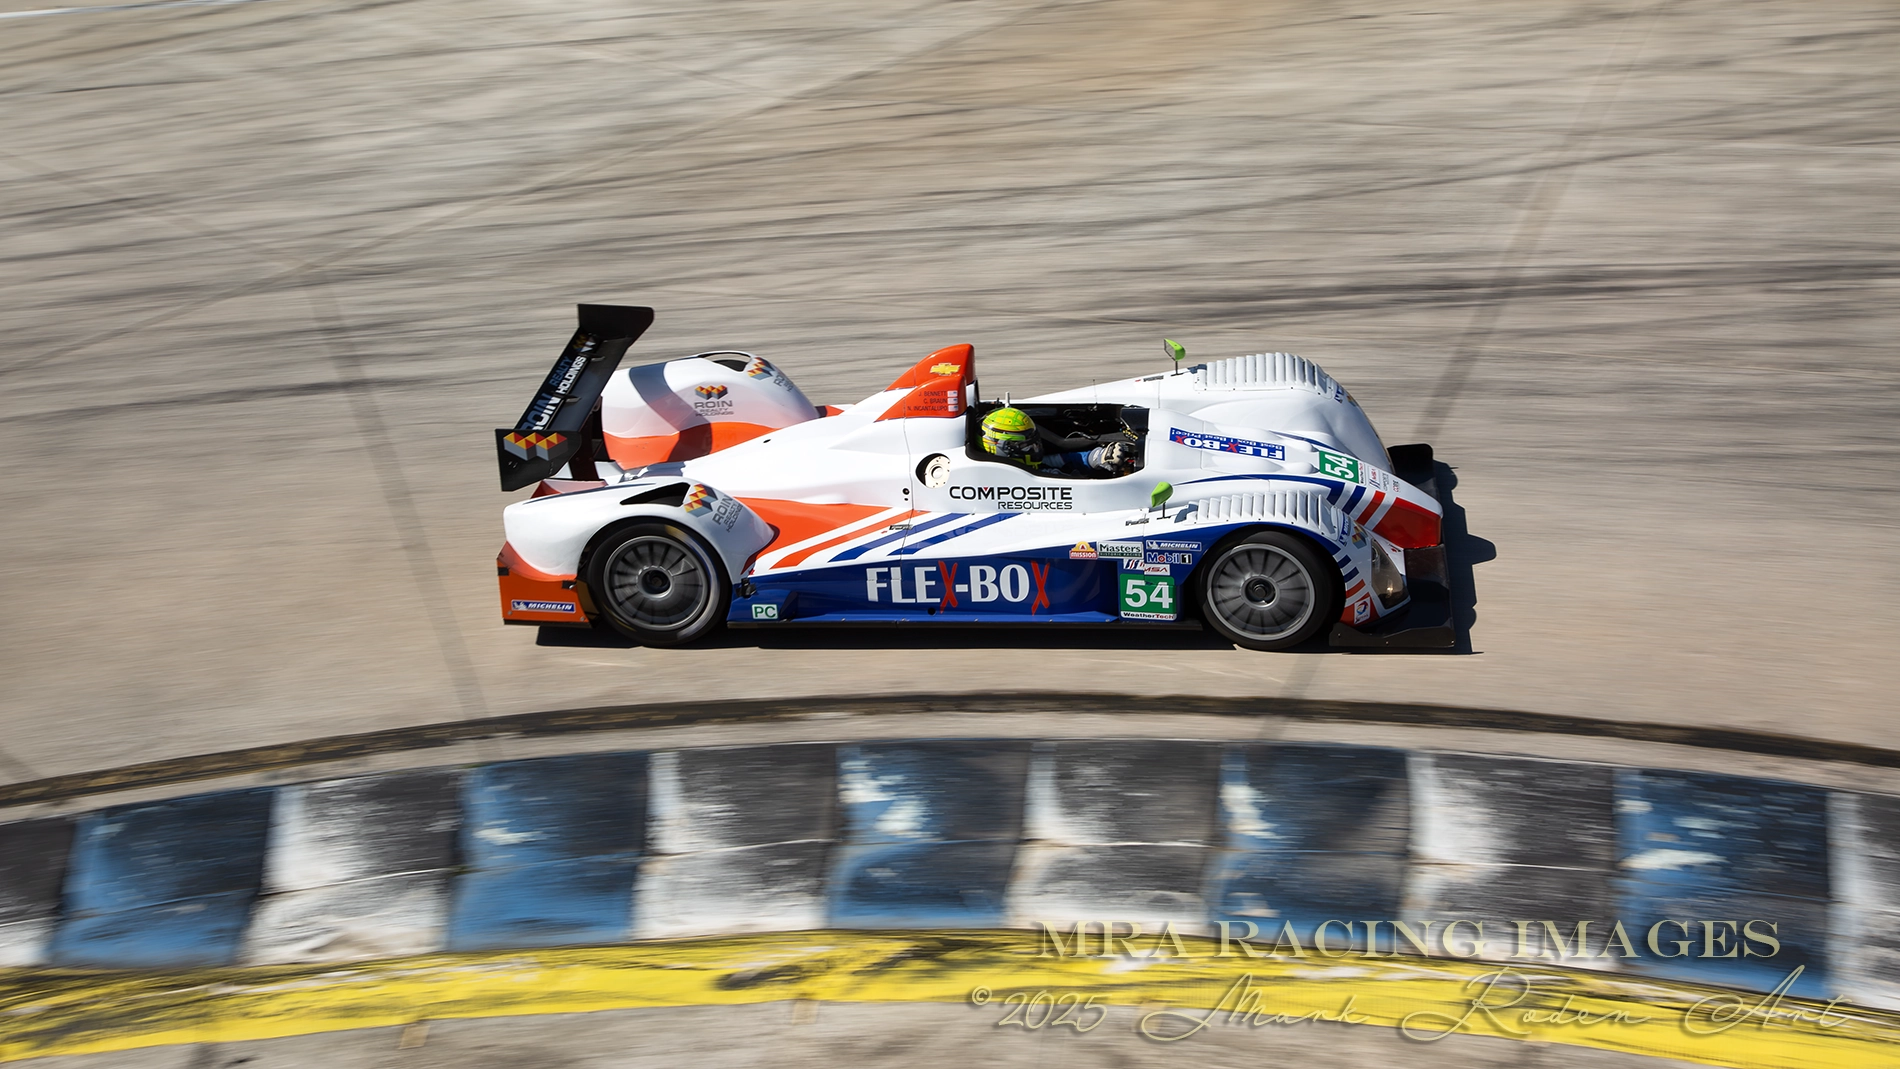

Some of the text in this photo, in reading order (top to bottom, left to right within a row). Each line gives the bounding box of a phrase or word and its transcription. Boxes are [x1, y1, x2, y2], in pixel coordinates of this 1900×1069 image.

[549, 356, 573, 387] REALTY
[556, 355, 587, 394] HOLDINGS
[694, 400, 733, 409] ROIN
[1175, 435, 1283, 459] FLEX-BOX
[1324, 454, 1355, 479] 54
[949, 486, 1073, 500] COMPOSITE
[712, 494, 734, 526] ROIN
[998, 501, 1073, 510] RESOURCES
[1099, 543, 1141, 553] Masters
[1147, 552, 1180, 564] Mobil
[866, 560, 1050, 616] FLEX-BOX
[1125, 579, 1173, 609] 54
[528, 602, 573, 611] MICHELIN
[754, 605, 776, 618] PC
[1123, 612, 1175, 620] WeatherTech
